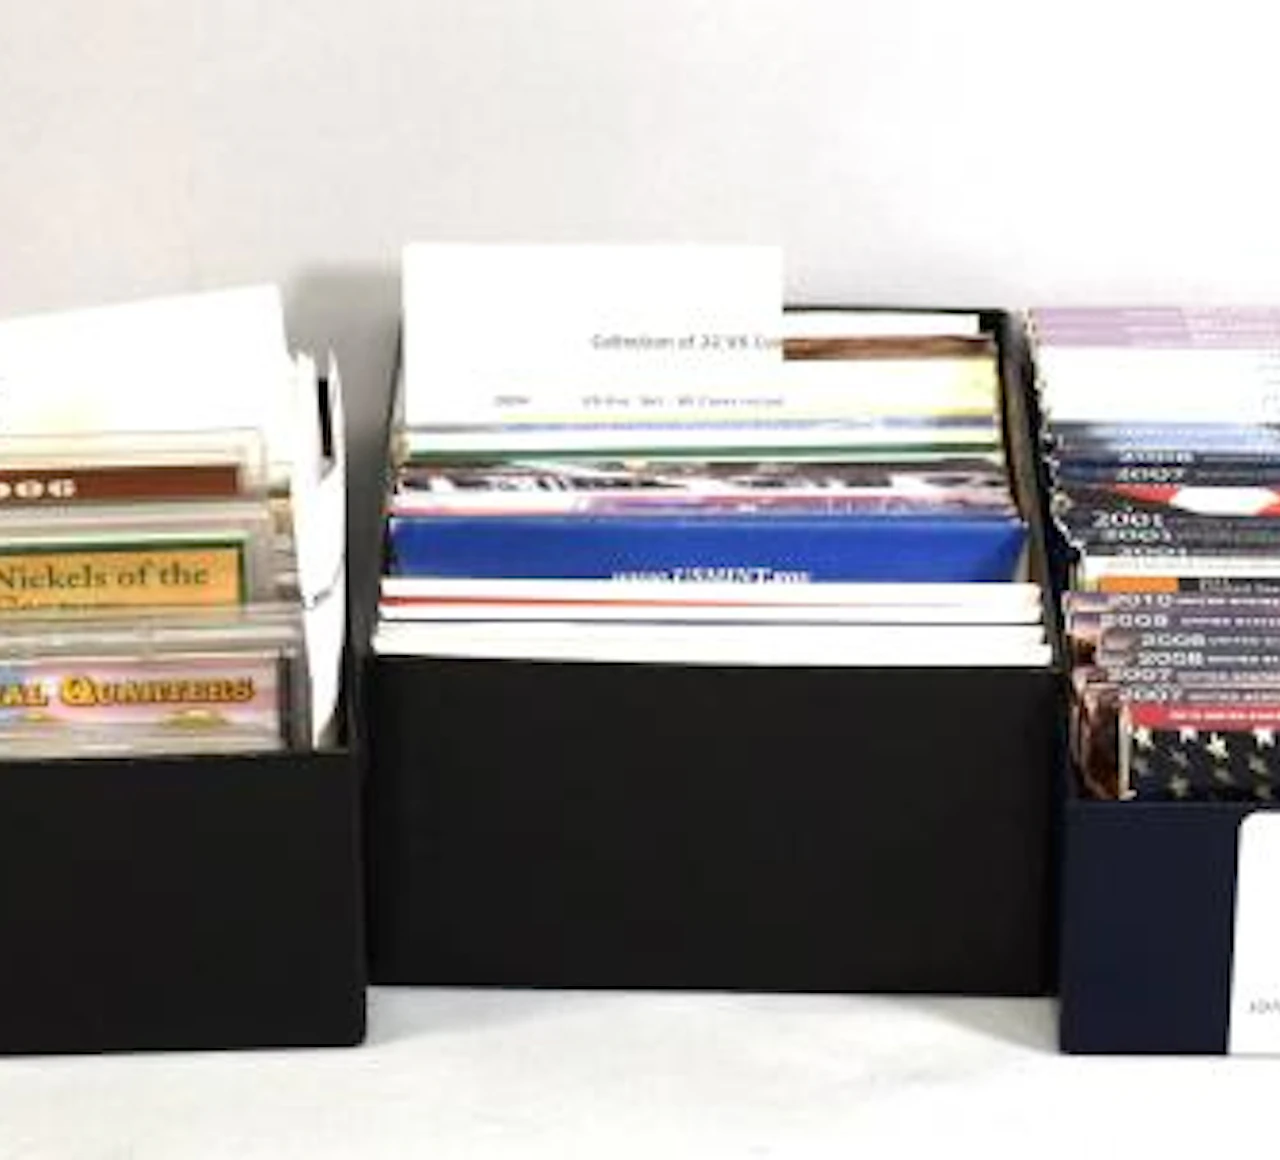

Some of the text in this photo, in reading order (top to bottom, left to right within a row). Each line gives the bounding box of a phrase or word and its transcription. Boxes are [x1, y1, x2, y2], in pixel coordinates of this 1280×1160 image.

[116, 560, 156, 589] of
[158, 560, 211, 587] the
[60, 673, 257, 707] QUARTERS
